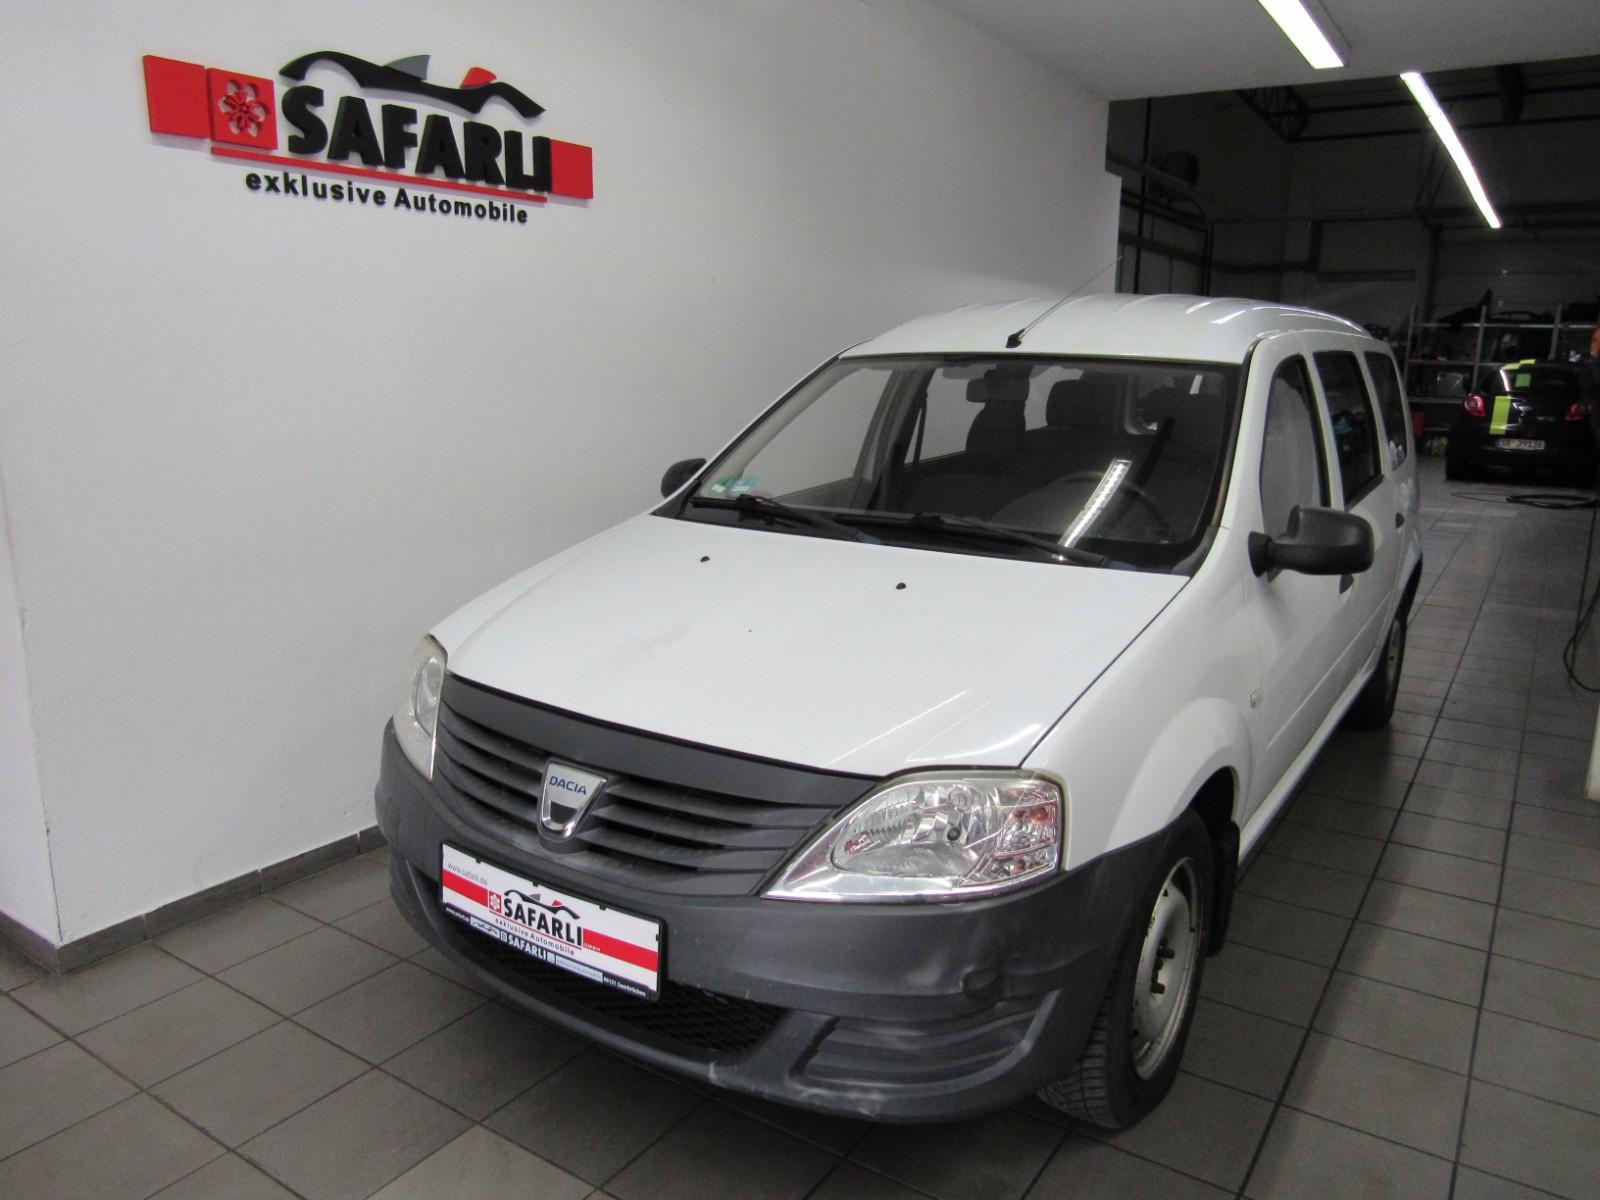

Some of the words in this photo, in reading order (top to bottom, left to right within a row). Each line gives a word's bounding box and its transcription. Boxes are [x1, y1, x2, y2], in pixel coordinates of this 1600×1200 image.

[281, 85, 553, 192] SAFARLI
[245, 169, 386, 206] exklusive
[393, 188, 528, 225] Automobile
[549, 775, 587, 796] DACIA
[503, 897, 582, 946] SAFARLI
[508, 934, 547, 961] SAFARLI
[530, 932, 575, 956] Automobile
